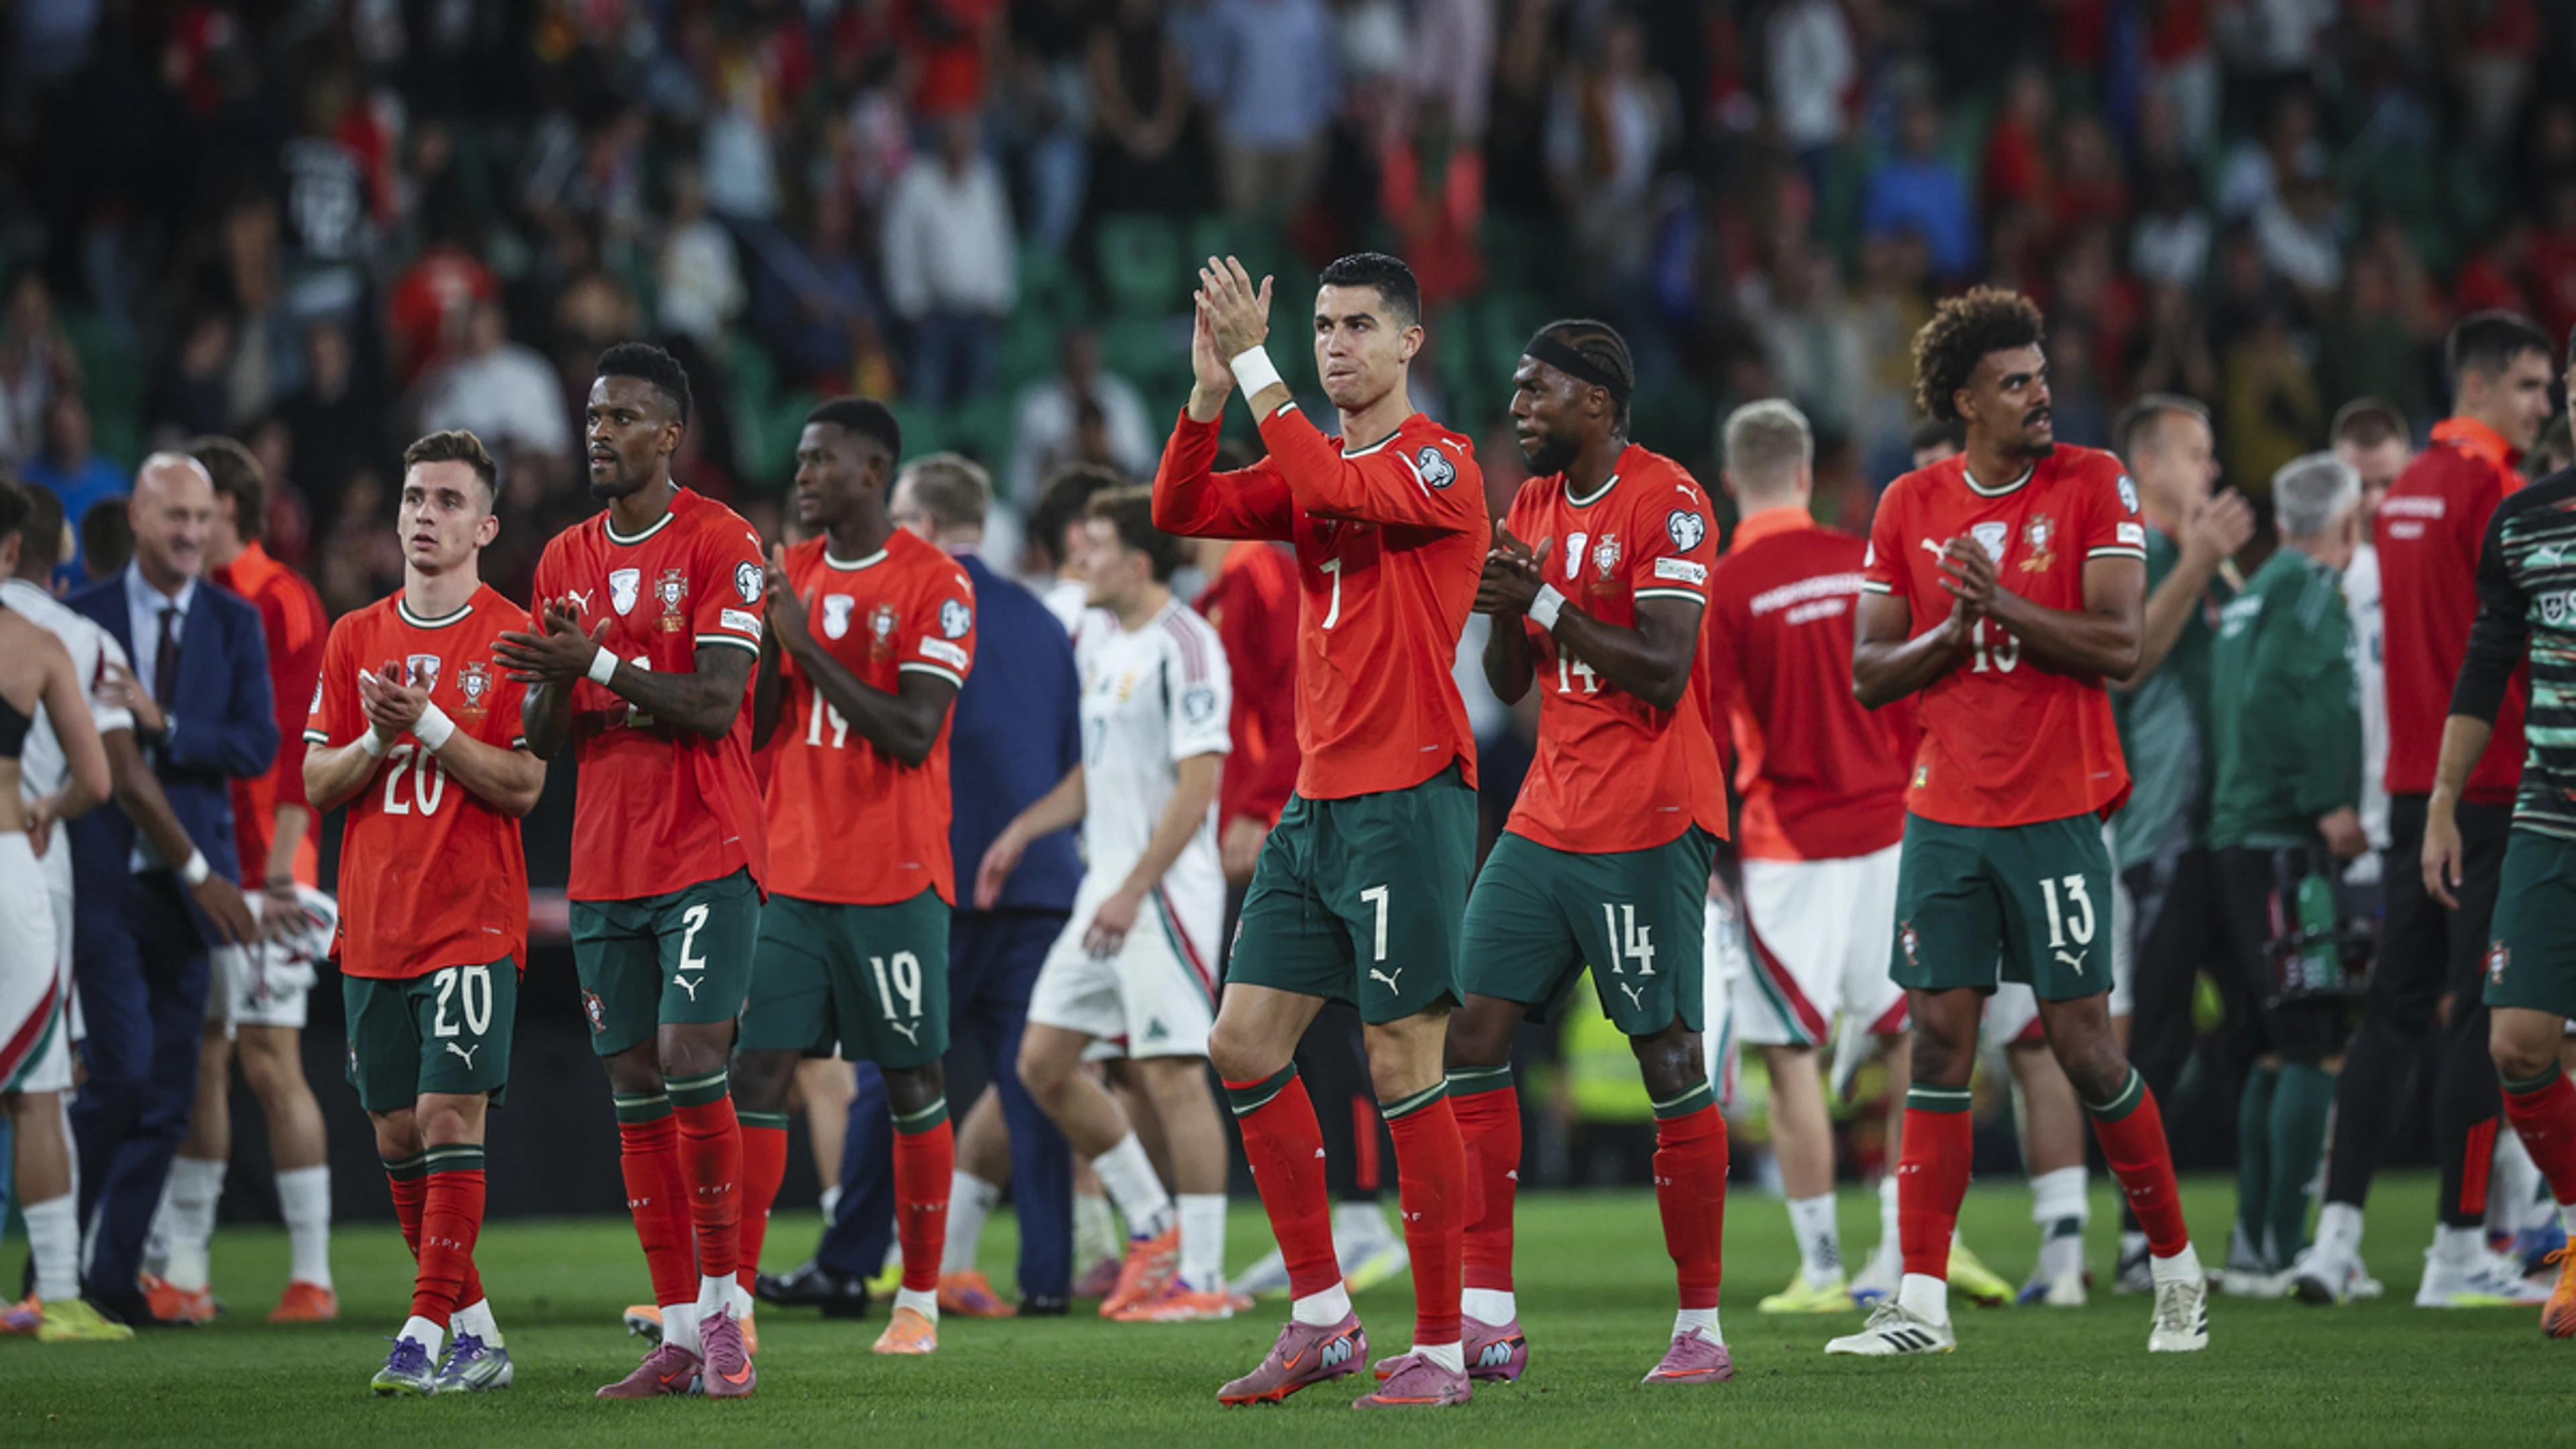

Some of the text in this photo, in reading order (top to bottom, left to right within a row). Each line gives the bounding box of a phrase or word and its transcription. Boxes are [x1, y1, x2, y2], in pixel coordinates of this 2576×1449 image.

[1320, 558, 1340, 629] 7
[384, 743, 445, 816] 20
[678, 904, 709, 969] 2
[1360, 884, 1389, 961] 7
[1602, 903, 1656, 975] 14
[2039, 873, 2094, 947] 13
[433, 964, 492, 1037] 20
[869, 951, 923, 1019] 19
